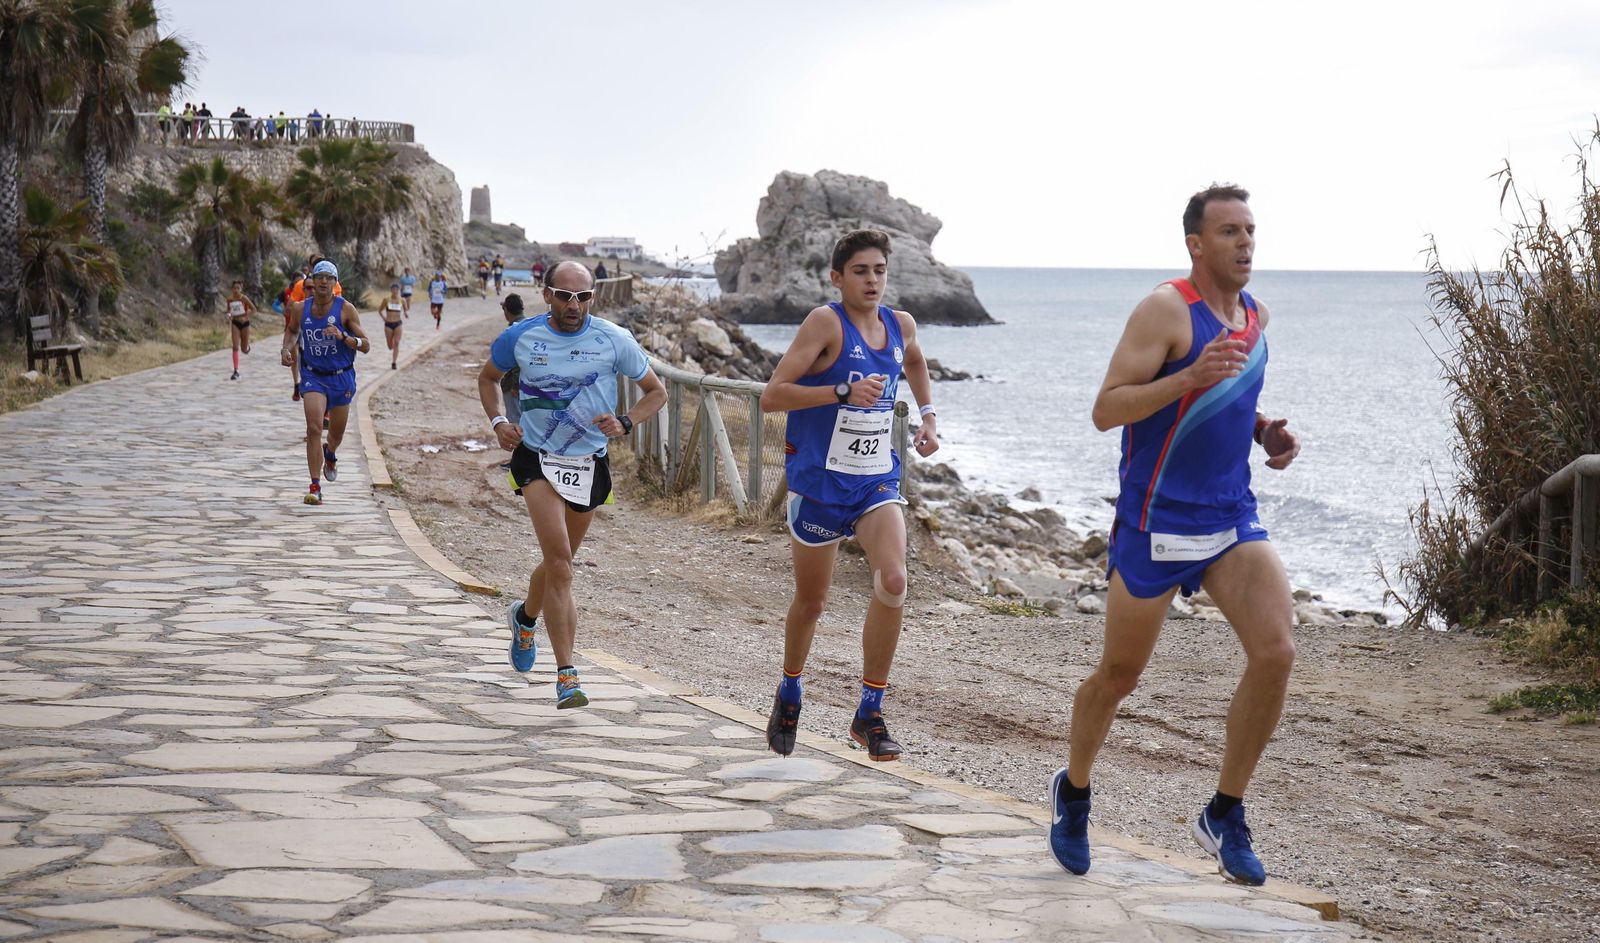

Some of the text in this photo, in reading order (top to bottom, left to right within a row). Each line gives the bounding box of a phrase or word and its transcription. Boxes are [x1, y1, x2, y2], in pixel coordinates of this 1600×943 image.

[309, 344, 338, 356] 1873
[847, 438, 880, 456] 432
[554, 469, 581, 487] 162
